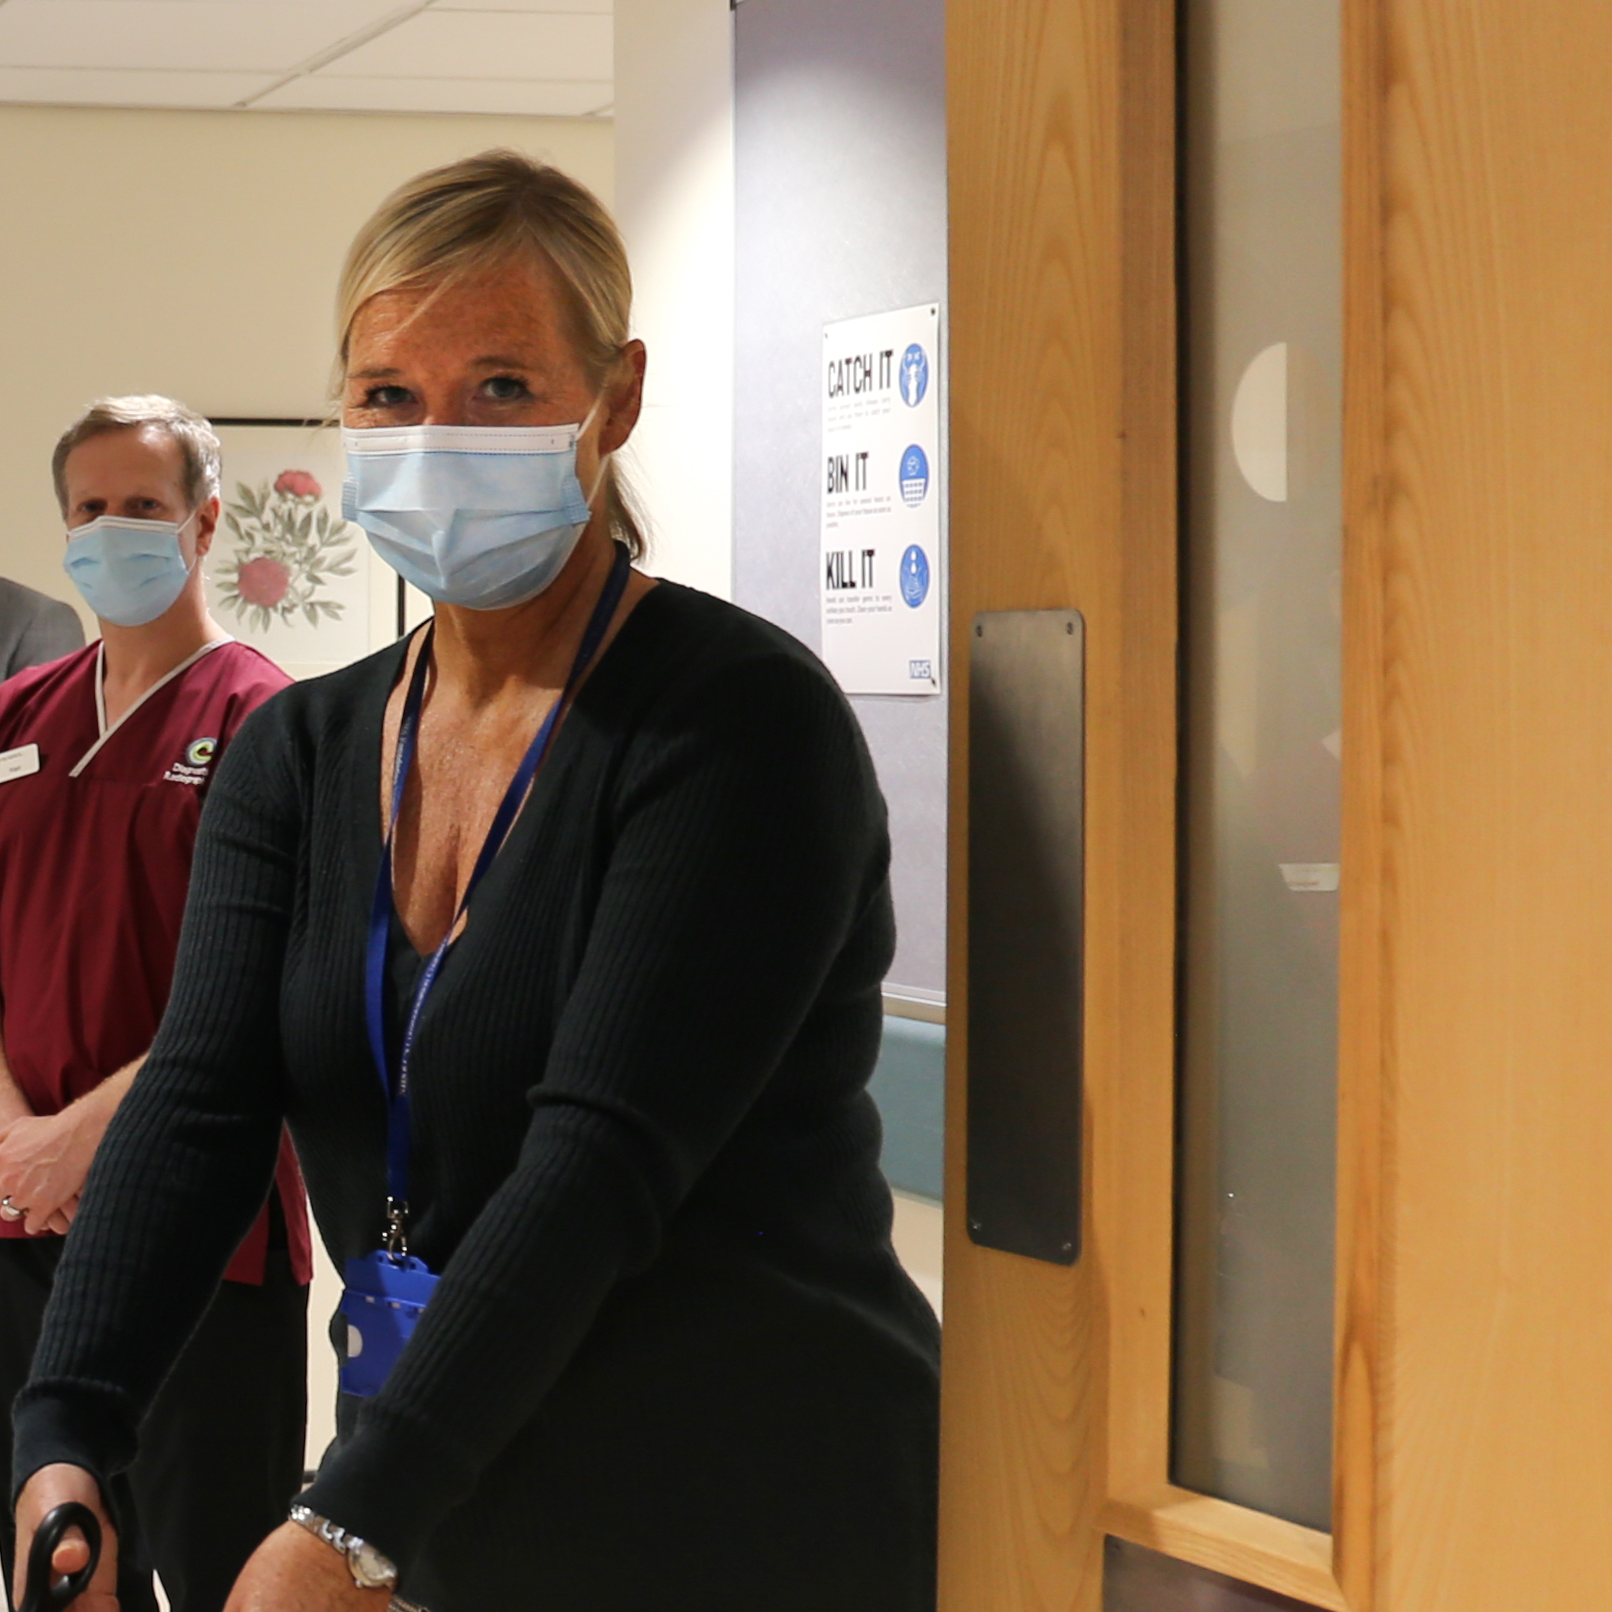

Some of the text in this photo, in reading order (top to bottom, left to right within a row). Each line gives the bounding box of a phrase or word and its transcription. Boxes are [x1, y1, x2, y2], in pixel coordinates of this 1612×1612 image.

[828, 349, 893, 399] CATCH IT
[827, 451, 869, 494] BIN IT
[826, 549, 875, 590] KILL IT
[910, 661, 931, 678] NHS
